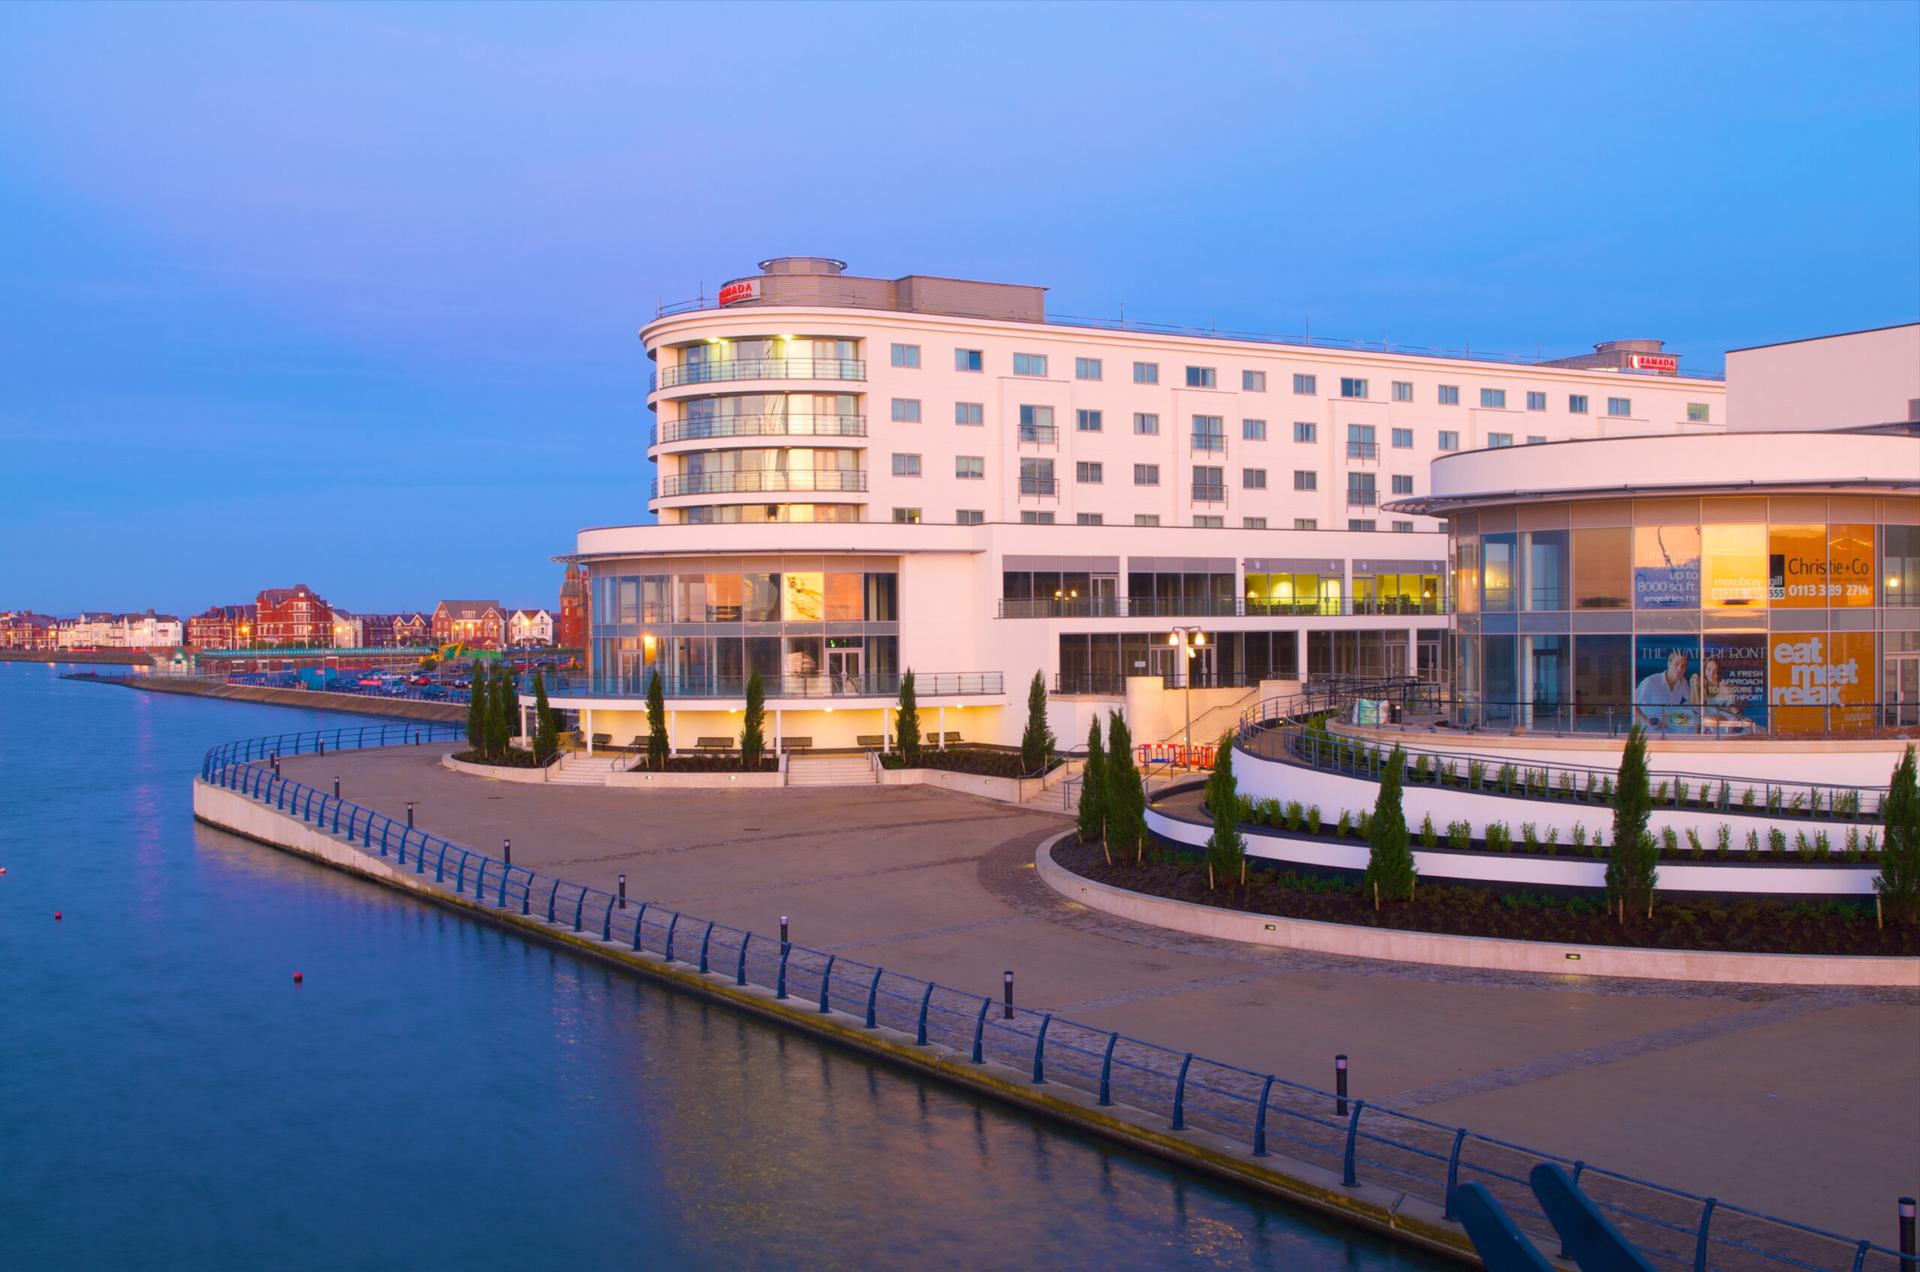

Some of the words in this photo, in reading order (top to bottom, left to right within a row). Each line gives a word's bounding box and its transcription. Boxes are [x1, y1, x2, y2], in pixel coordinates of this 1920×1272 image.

[1669, 571, 1684, 583] up
[1686, 571, 1698, 580] to
[1637, 581, 1667, 592] 8000
[1788, 584, 1817, 597] 0113
[1644, 593, 1685, 603] enquiries
[1641, 647, 1667, 659] THE
[1774, 636, 1823, 664] eat
[1791, 658, 1859, 685] meet
[1720, 678, 1763, 686] APPROACH
[1755, 686, 1763, 694] IN
[1772, 684, 1845, 706] relax
